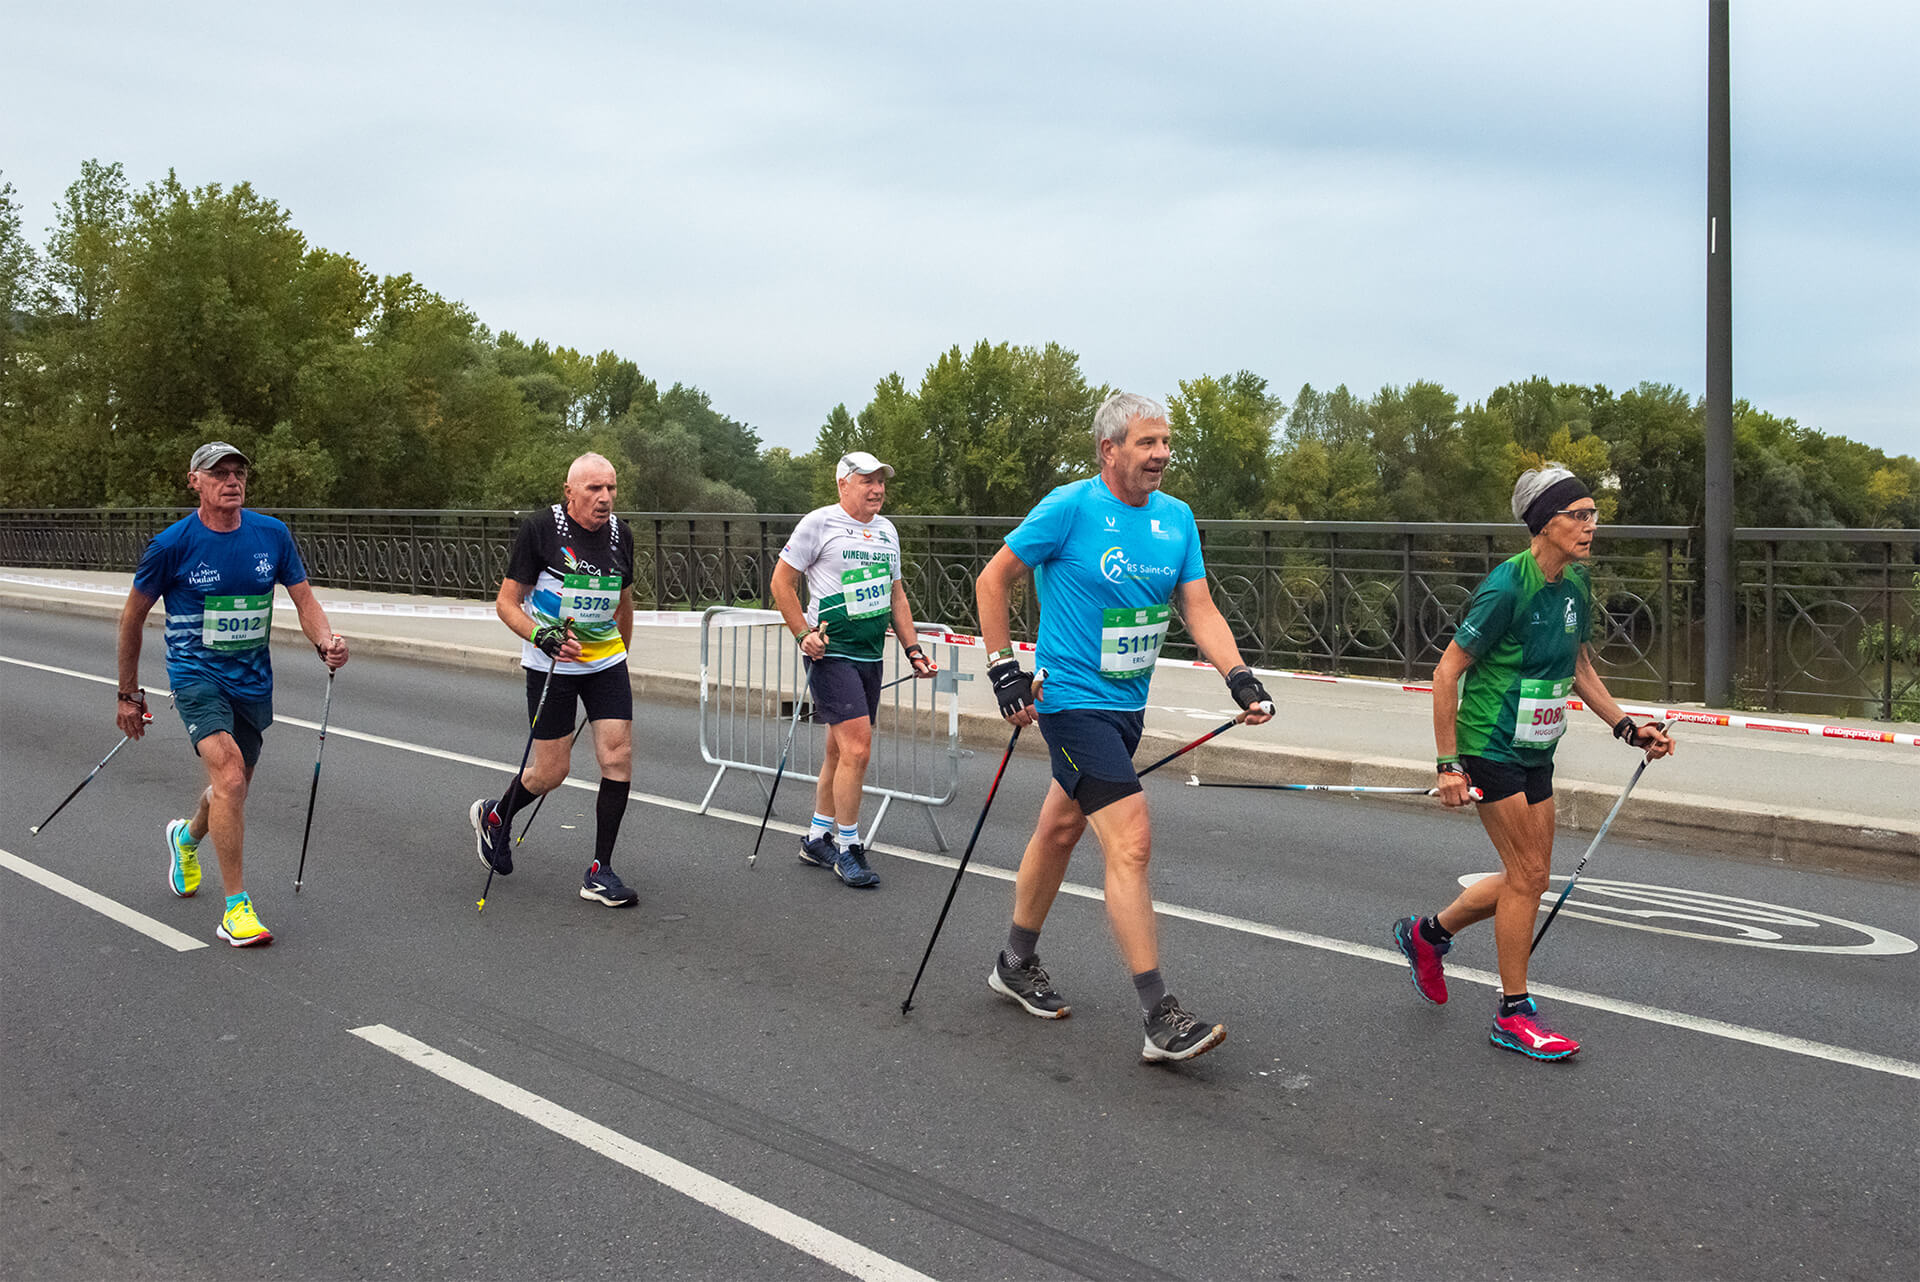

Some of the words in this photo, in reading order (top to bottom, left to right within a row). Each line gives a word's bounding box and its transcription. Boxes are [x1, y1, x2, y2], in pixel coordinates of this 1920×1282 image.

[1127, 563, 1138, 573] RS
[1139, 564, 1177, 576] Saint-Cyr
[188, 573, 221, 584] Poulard
[855, 583, 886, 602] 5181
[572, 595, 610, 611] 5378
[217, 616, 262, 632] 5012
[1117, 632, 1159, 655] 5111
[1132, 656, 1146, 664] ERIC
[1824, 726, 1882, 741] République
